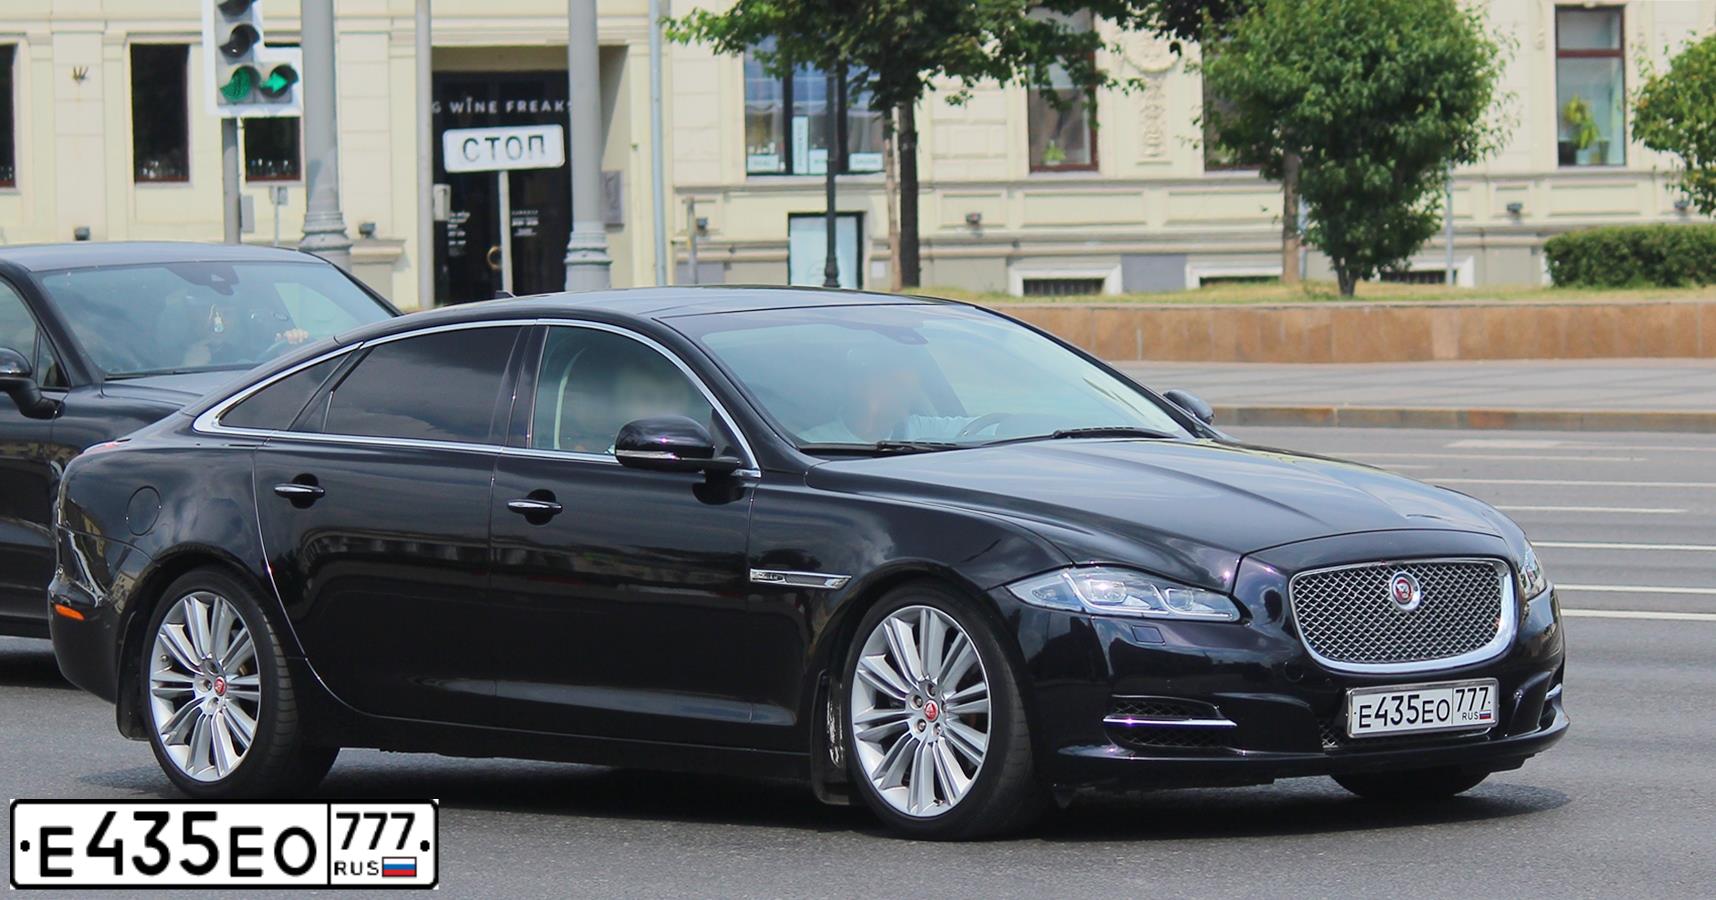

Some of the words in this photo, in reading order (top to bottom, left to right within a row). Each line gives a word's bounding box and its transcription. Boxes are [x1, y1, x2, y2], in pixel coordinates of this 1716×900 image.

[463, 135, 545, 161] СТОП
[1358, 694, 1450, 728] E435EO
[1455, 687, 1489, 712] 777
[1461, 711, 1479, 721] RUS
